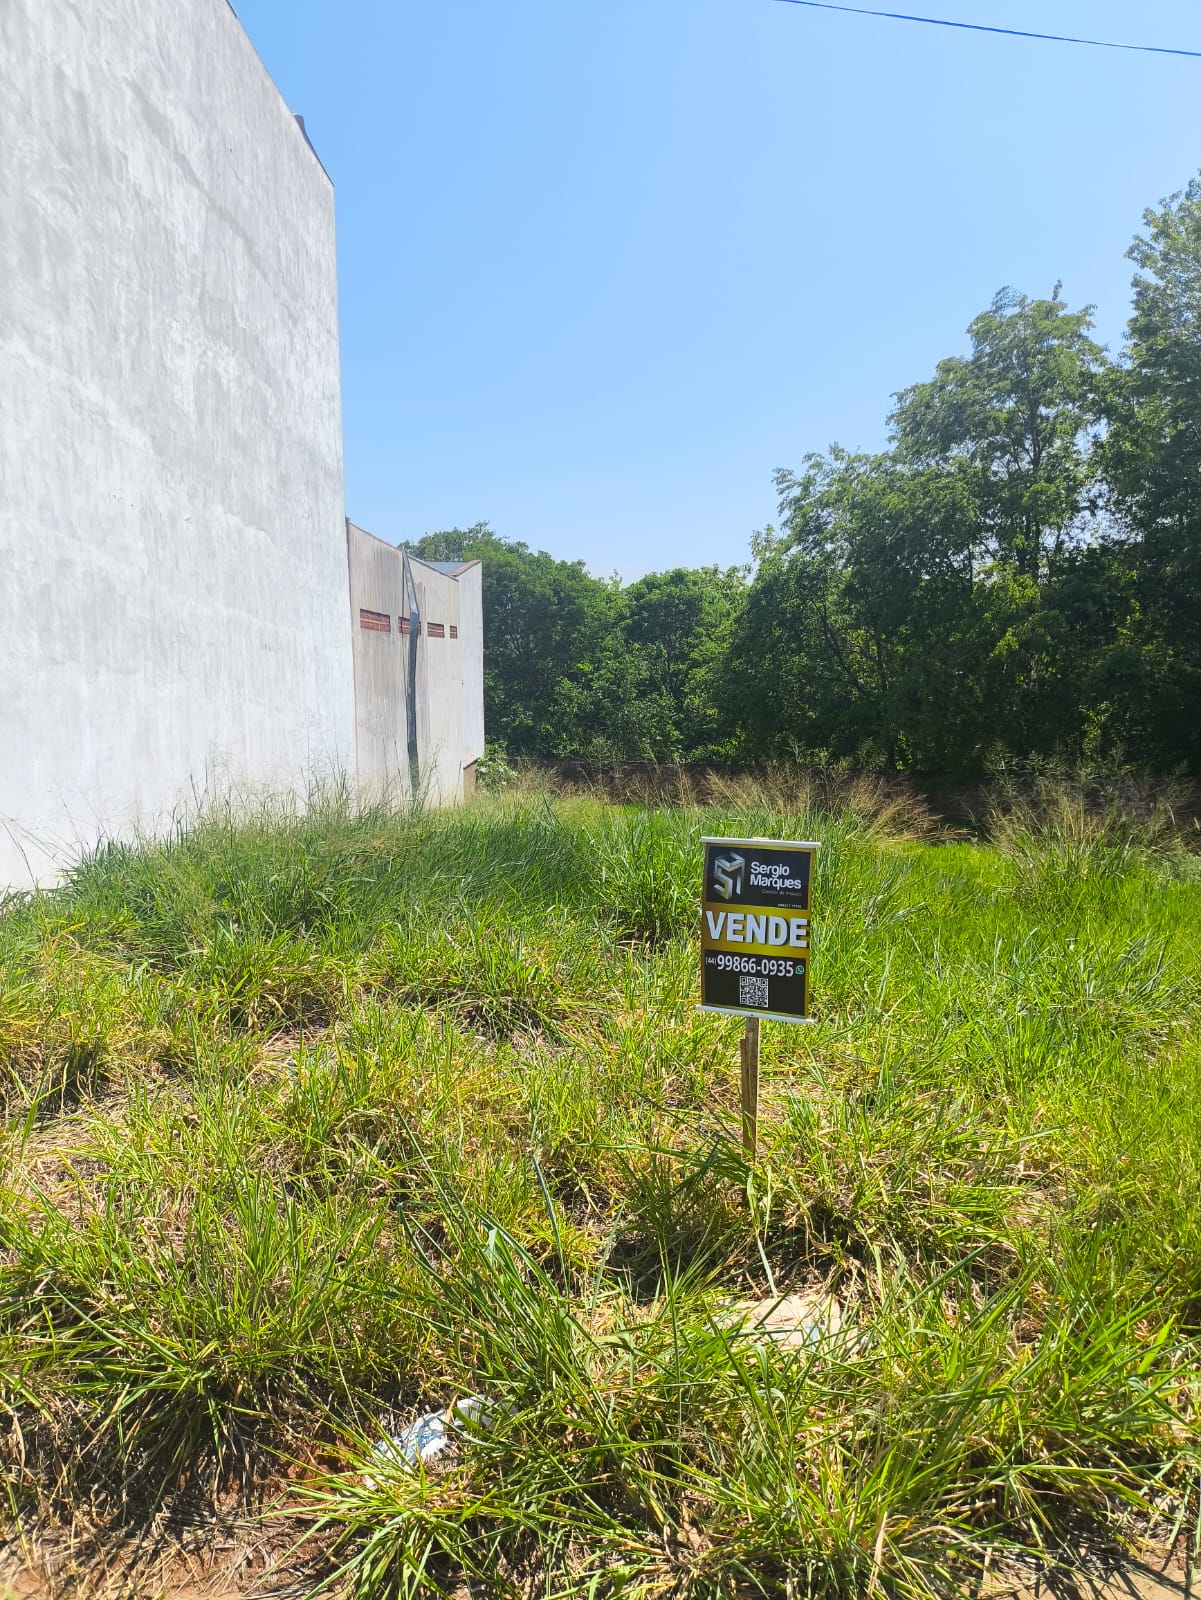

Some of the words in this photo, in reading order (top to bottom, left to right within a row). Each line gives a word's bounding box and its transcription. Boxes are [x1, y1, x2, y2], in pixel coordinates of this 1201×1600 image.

[750, 861, 790, 878] Sergio
[750, 874, 802, 890] Marques
[705, 910, 808, 948] VENDE
[717, 954, 794, 977] 99866-0935
